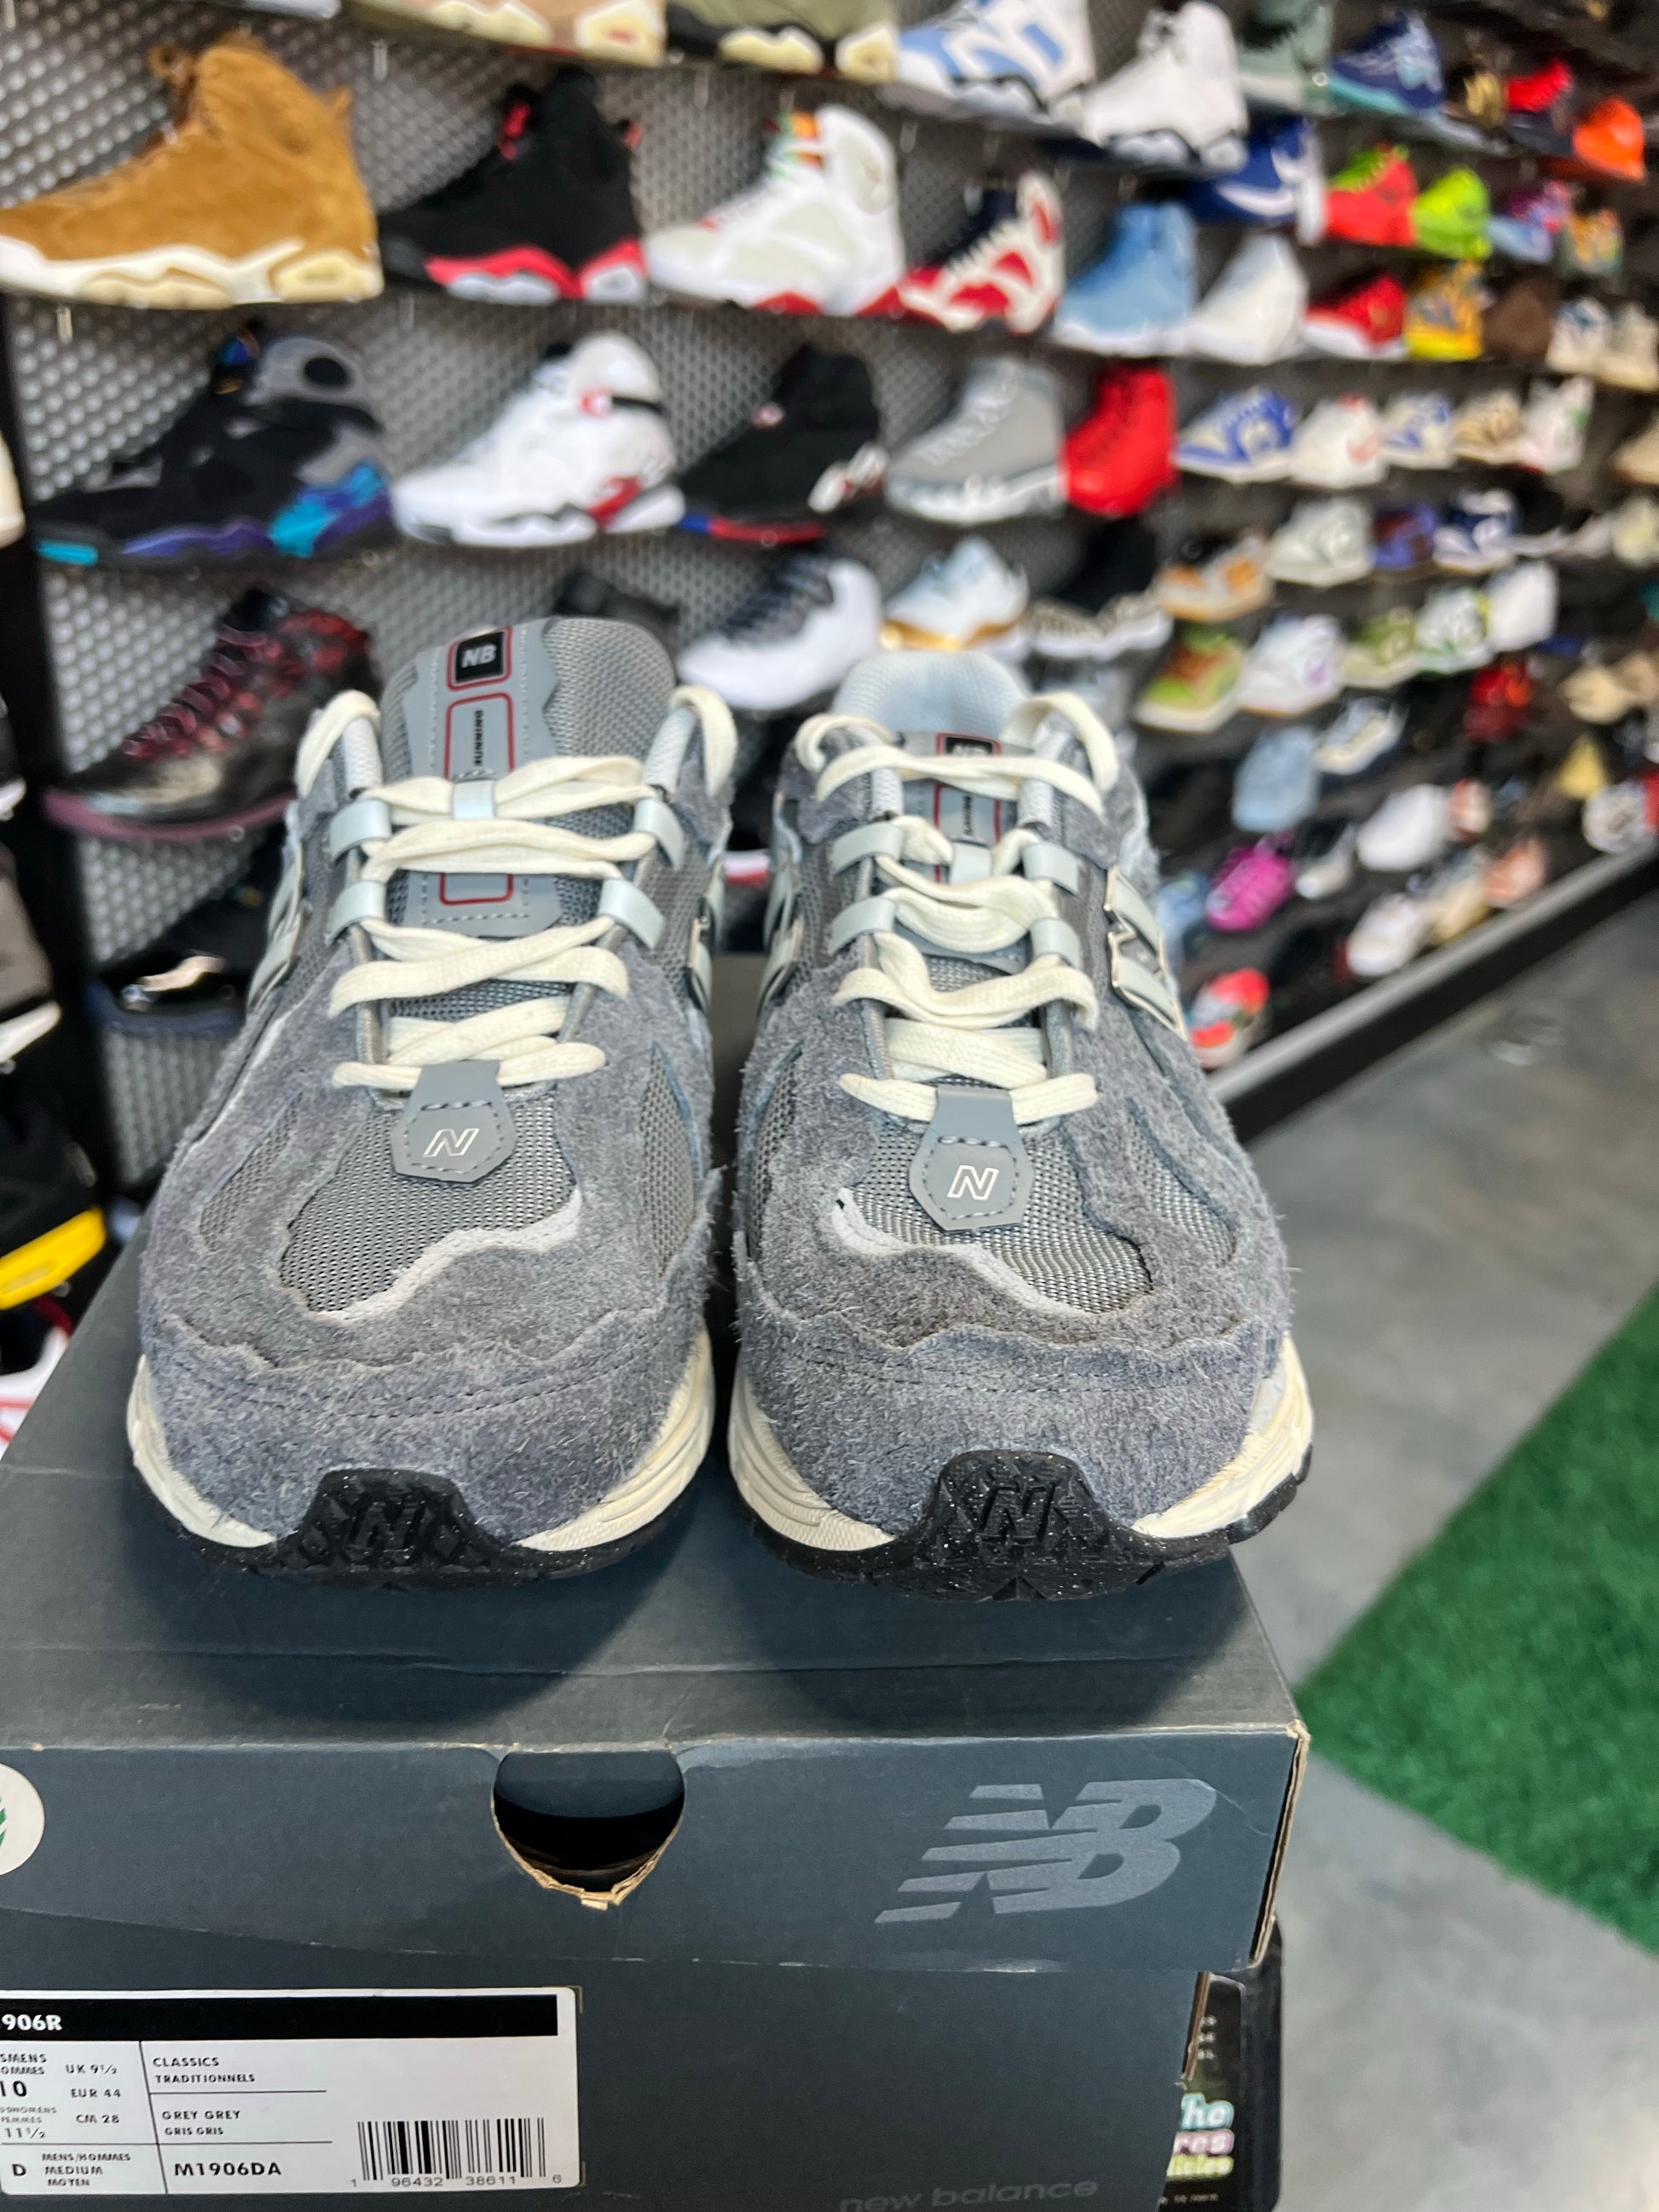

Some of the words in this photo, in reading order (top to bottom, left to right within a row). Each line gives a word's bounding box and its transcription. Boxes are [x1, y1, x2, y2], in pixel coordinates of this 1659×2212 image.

[461, 644, 496, 668] NB
[475, 710, 483, 765] RUNNING
[423, 1128, 480, 1157] N
[947, 1165, 999, 1200] N
[875, 1778, 1217, 1924] NB
[153, 2057, 220, 2067] CLASSICS
[66, 2065, 85, 2074] UK
[155, 2074, 255, 2083] TRADITIONNELS
[71, 2089, 98, 2098] EUR
[103, 2089, 121, 2098] 44
[76, 2114, 97, 2123] CM
[101, 2114, 119, 2123] 28
[162, 2111, 198, 2120] GREY
[205, 2111, 240, 2120] GREY
[12, 2163, 26, 2176] D
[45, 2166, 103, 2175] MEDIUM
[174, 2163, 282, 2176] M1906DA
[391, 2177, 443, 2187] 96432
[465, 2176, 517, 2186] 38611
[552, 2174, 562, 2184] 6
[931, 2180, 1099, 2208] balance
